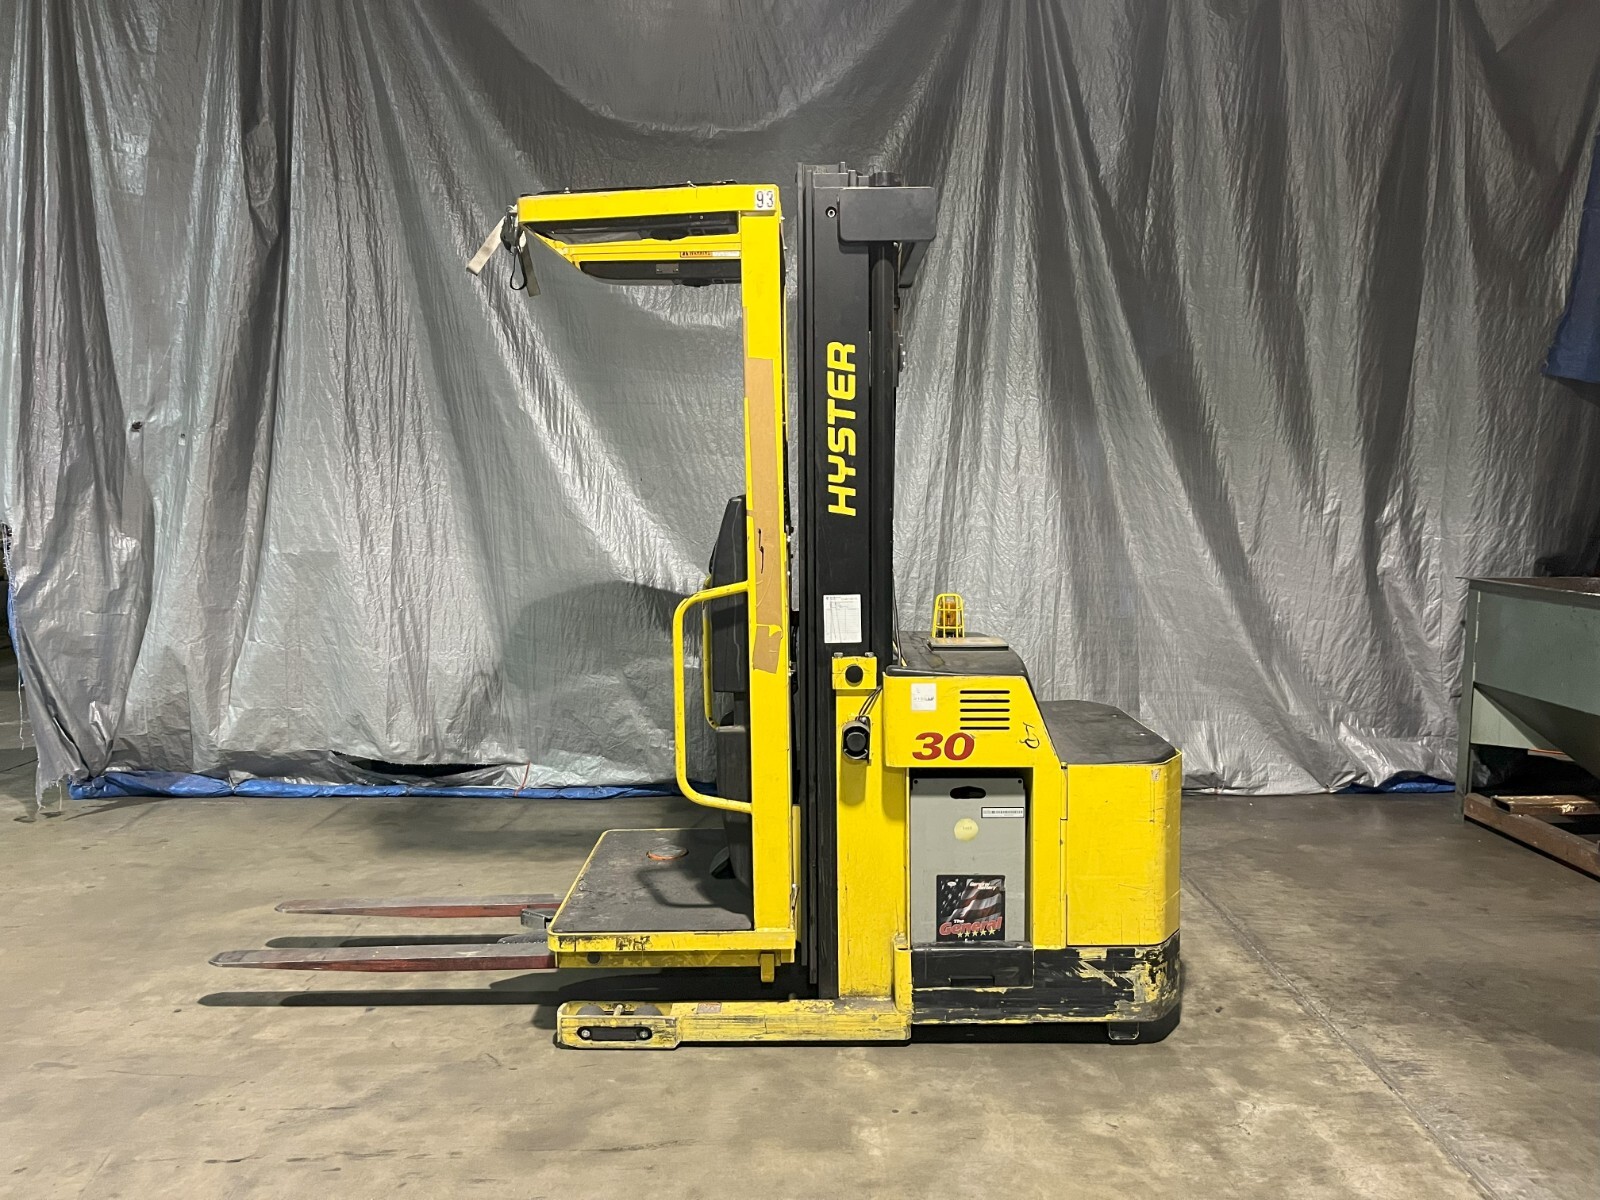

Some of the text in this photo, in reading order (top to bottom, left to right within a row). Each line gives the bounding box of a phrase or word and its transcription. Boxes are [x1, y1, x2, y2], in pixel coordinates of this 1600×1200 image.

[756, 190, 774, 208] 93
[827, 341, 857, 517] HYSTER
[911, 732, 975, 761] 30
[938, 916, 1003, 936] General
